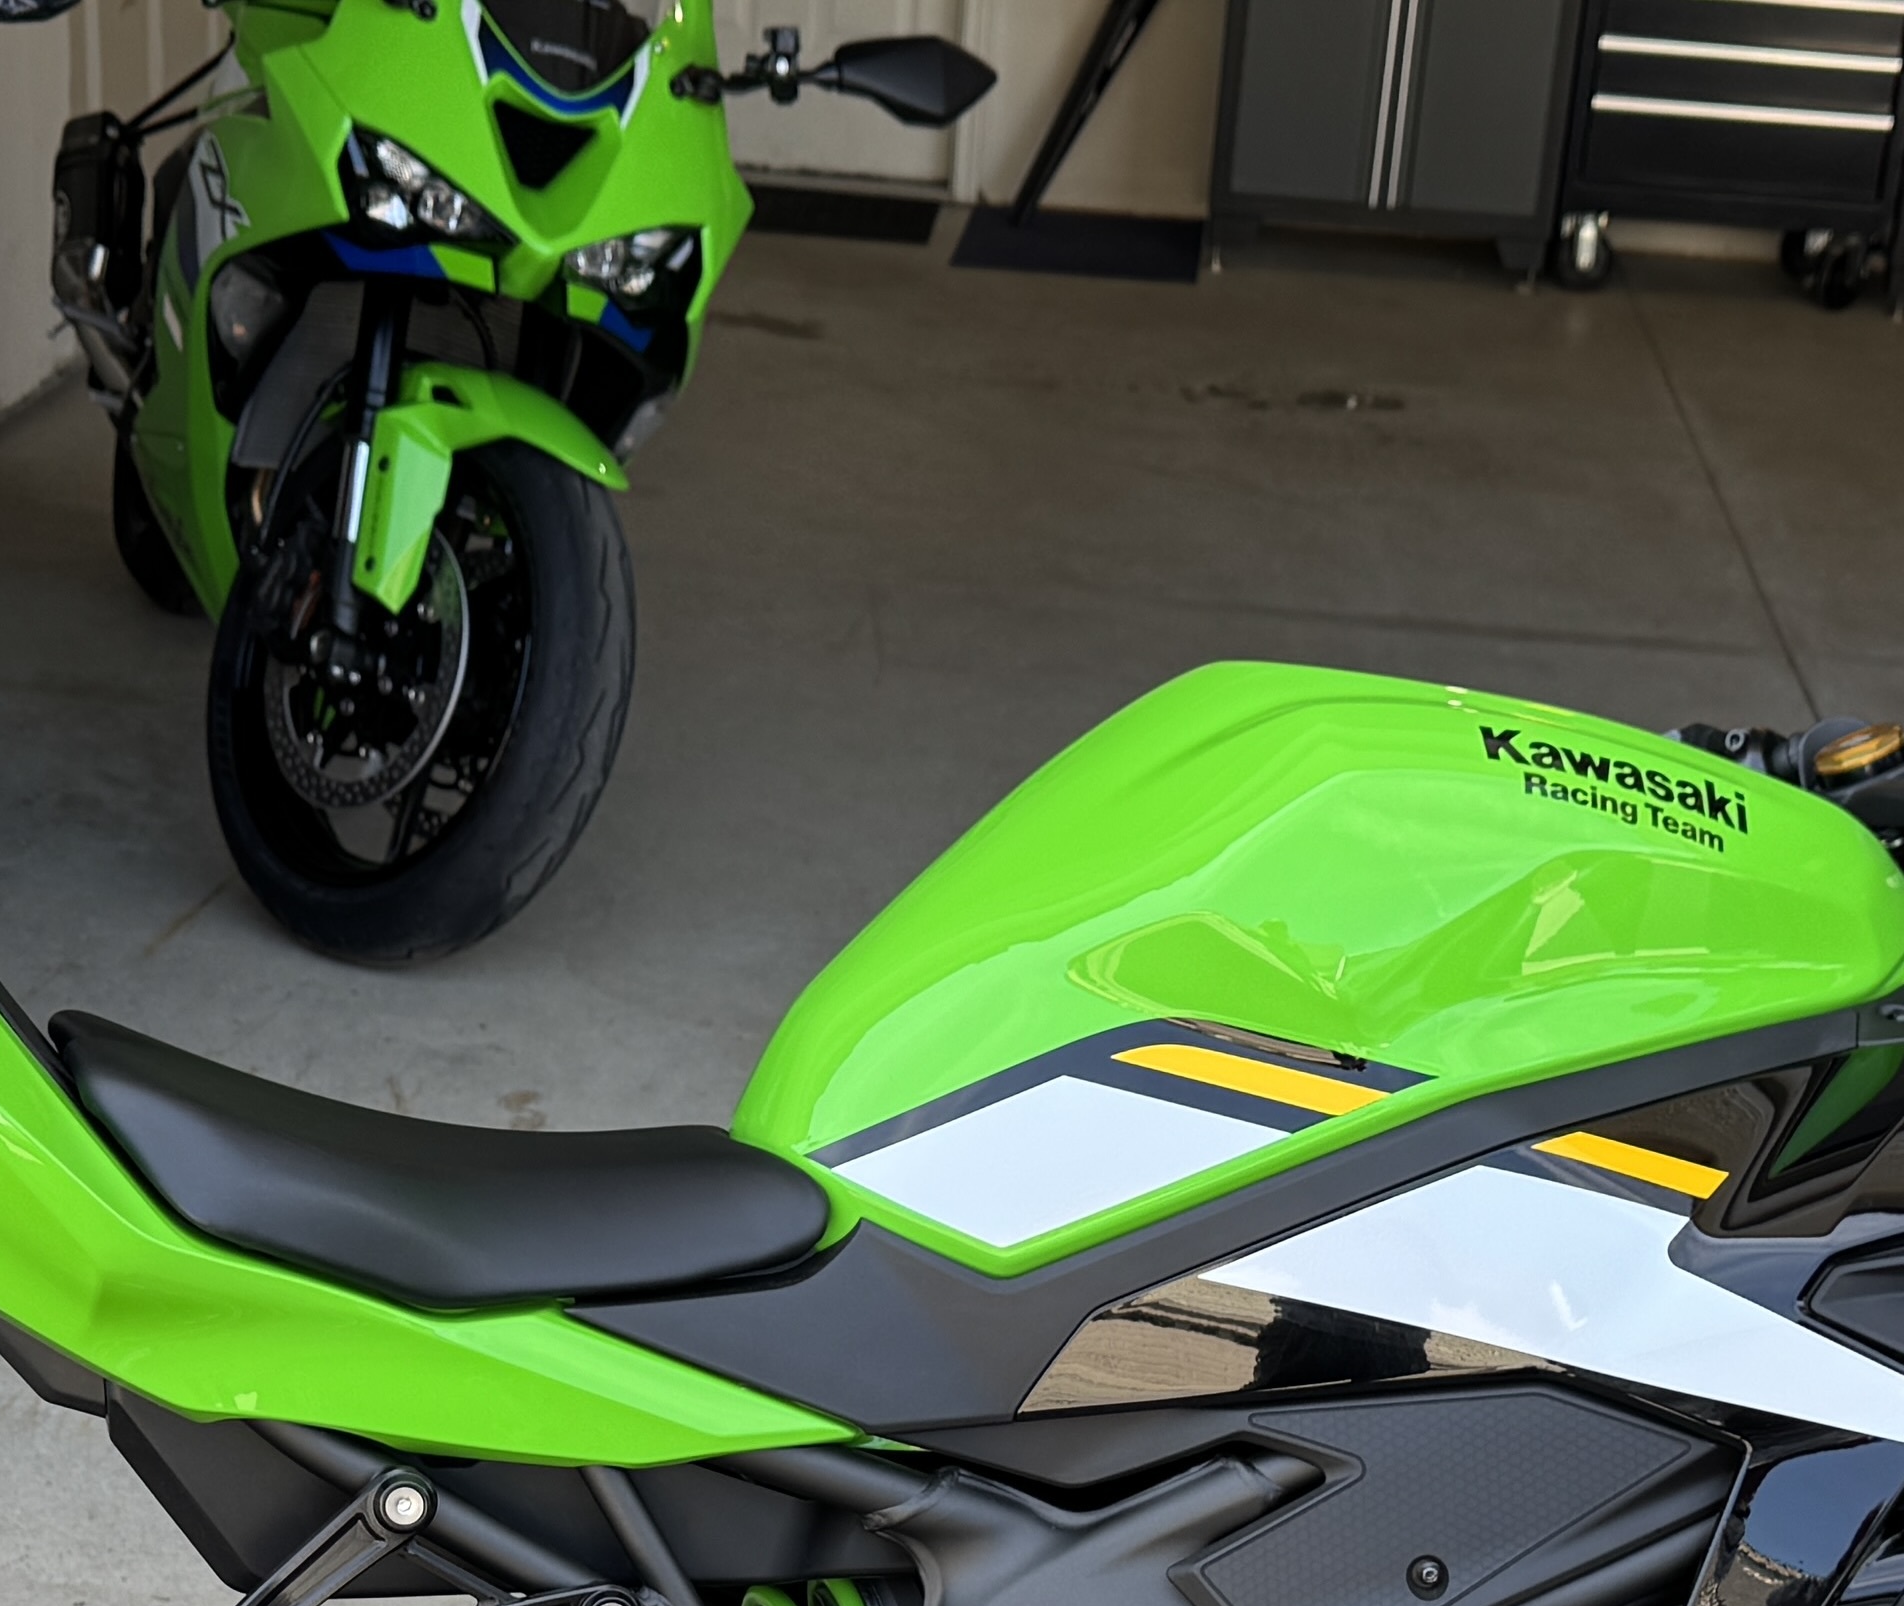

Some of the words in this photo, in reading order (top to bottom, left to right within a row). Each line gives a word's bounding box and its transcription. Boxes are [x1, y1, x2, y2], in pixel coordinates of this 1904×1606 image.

[1478, 725, 1749, 835] Kawasaki
[1523, 771, 1638, 826] Racing
[1644, 801, 1725, 853] Team
